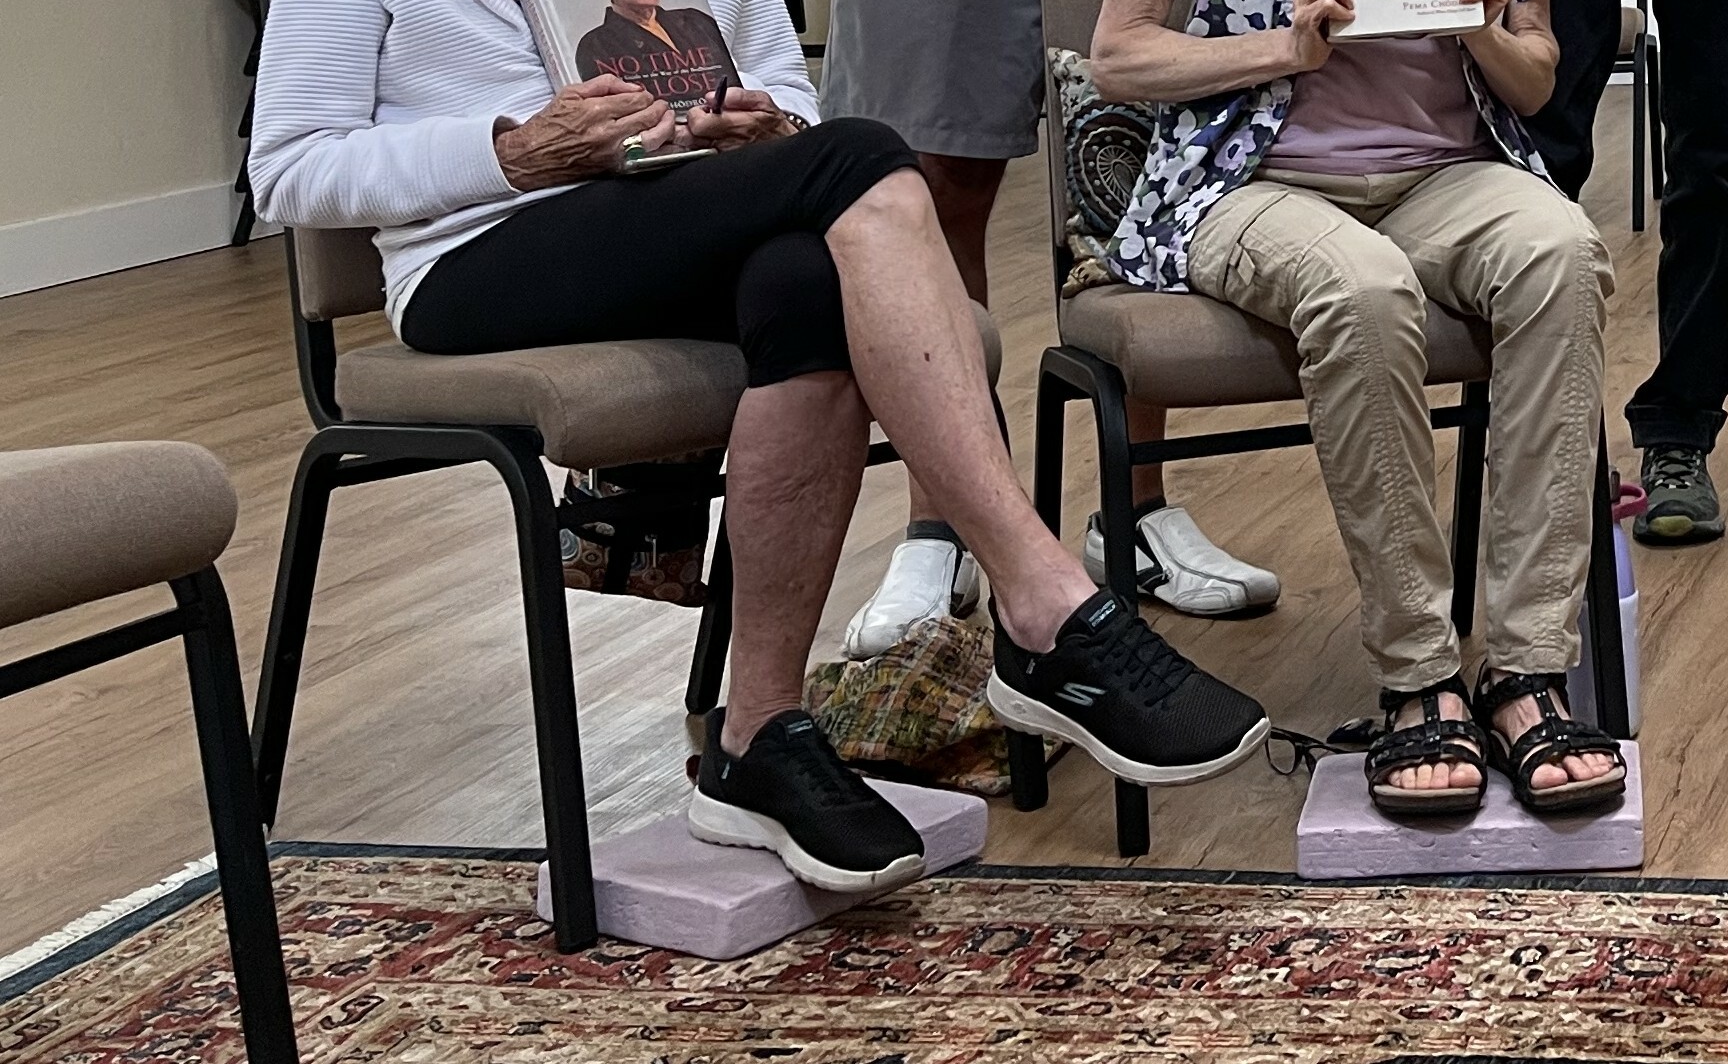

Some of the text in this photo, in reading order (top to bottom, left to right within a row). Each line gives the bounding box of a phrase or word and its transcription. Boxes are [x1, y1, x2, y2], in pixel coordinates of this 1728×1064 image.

[1402, 1, 1427, 11] PEMA
[594, 55, 641, 78] NO
[648, 46, 710, 73] TIME
[654, 71, 716, 97] LOSE
